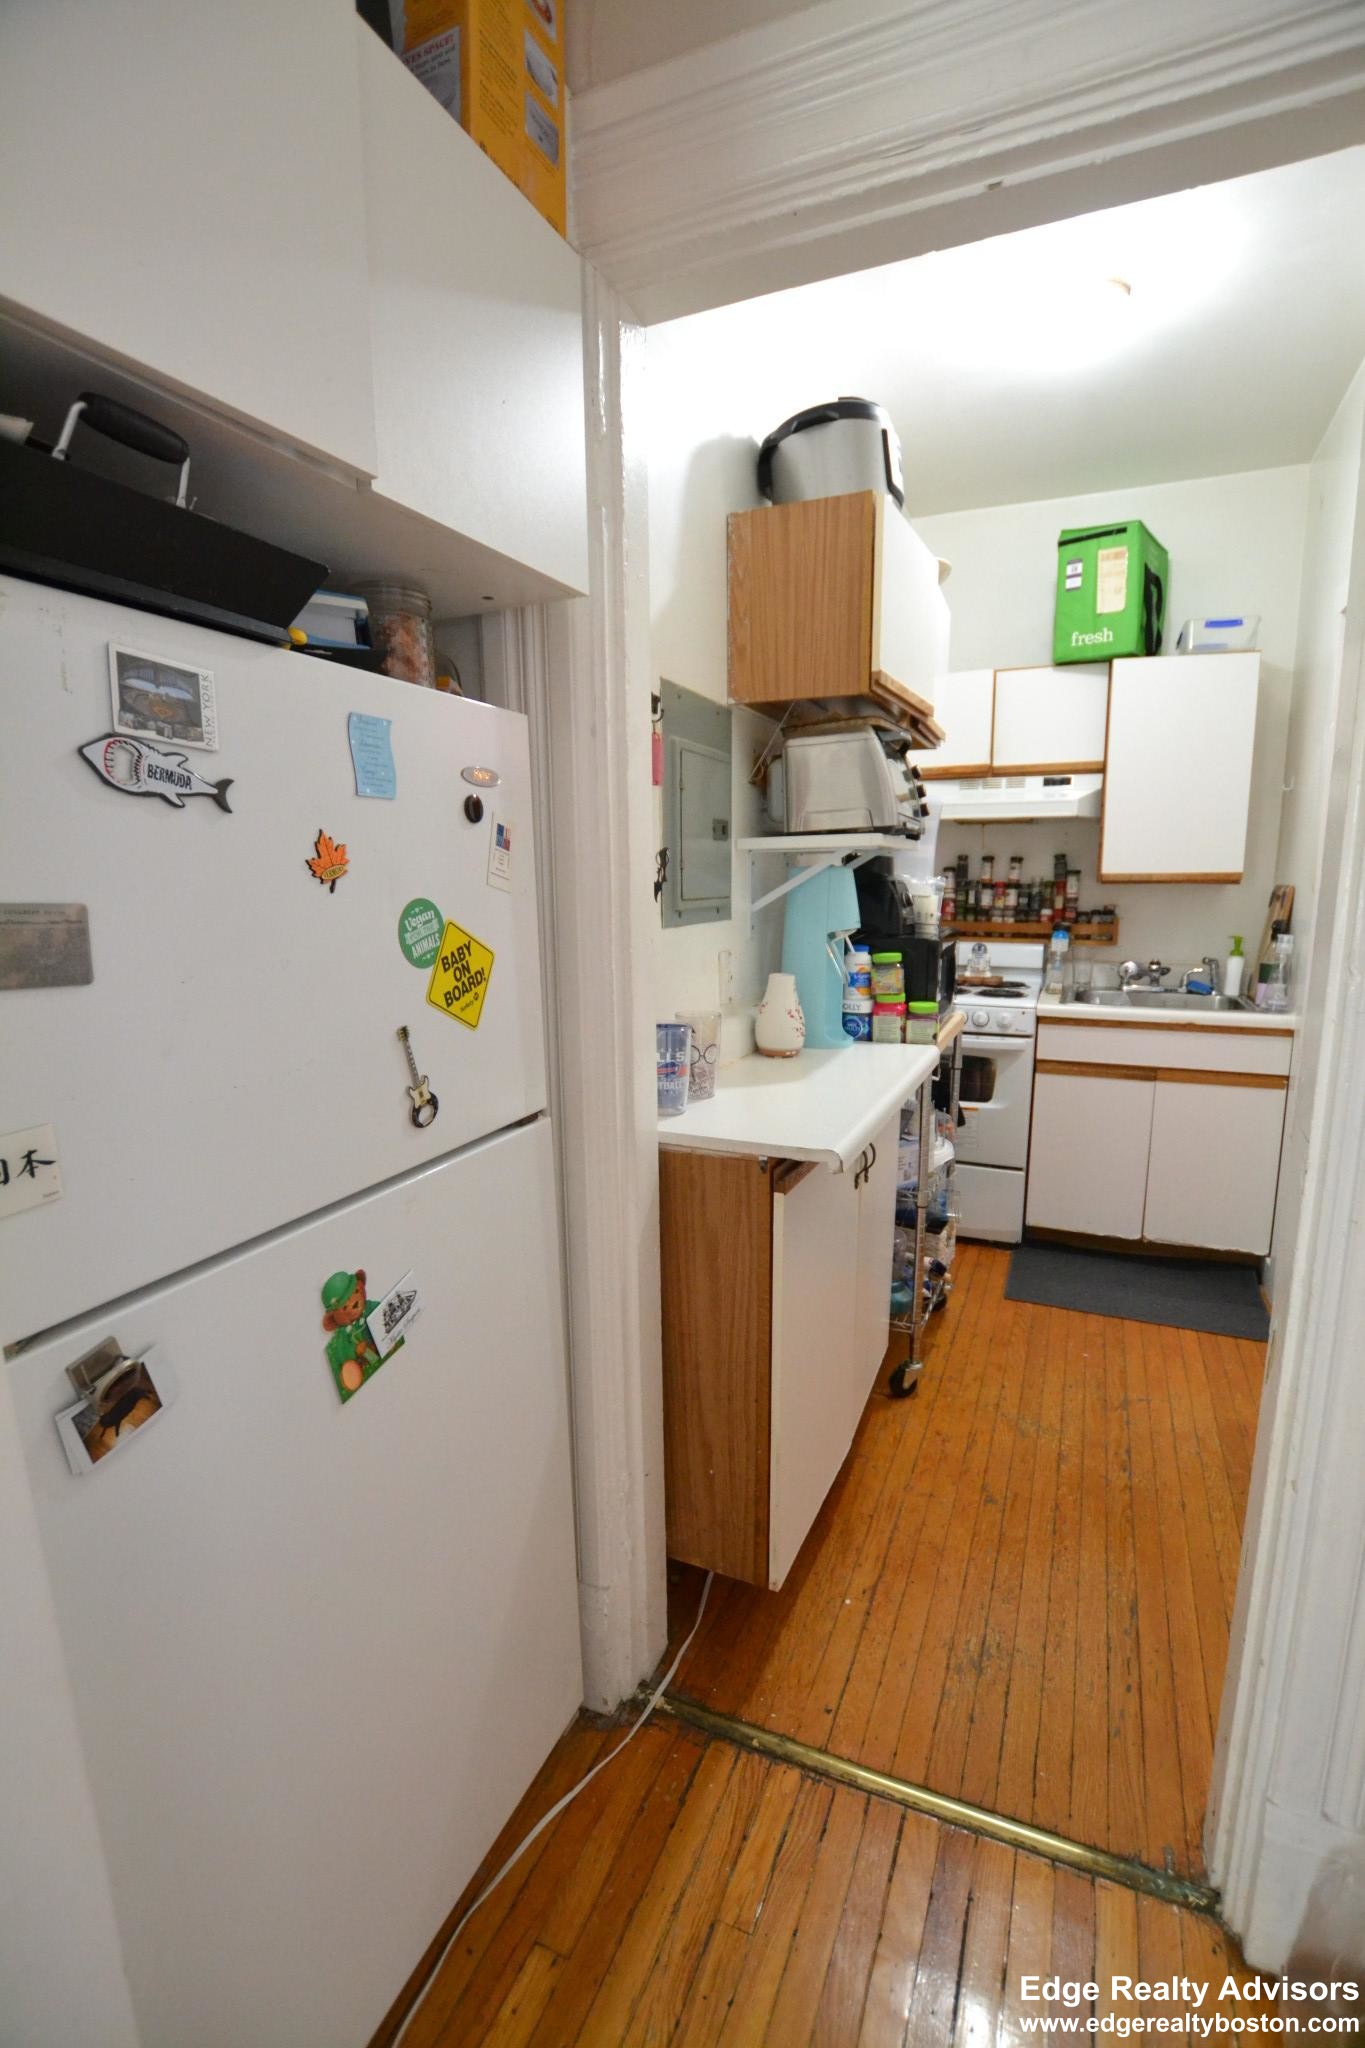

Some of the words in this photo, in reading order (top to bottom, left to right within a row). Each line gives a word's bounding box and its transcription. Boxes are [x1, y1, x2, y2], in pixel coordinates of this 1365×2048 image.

[1071, 627, 1114, 647] fresh
[200, 673, 210, 711] YORK
[203, 714, 214, 748] NEW
[147, 763, 193, 791] BERMUDA
[404, 910, 436, 932] Vegan
[411, 933, 441, 960] ANIMALS
[440, 939, 473, 974] BABY
[453, 960, 472, 983] ON
[443, 967, 487, 1009] BOARD!
[842, 1002, 862, 1011] OLLY
